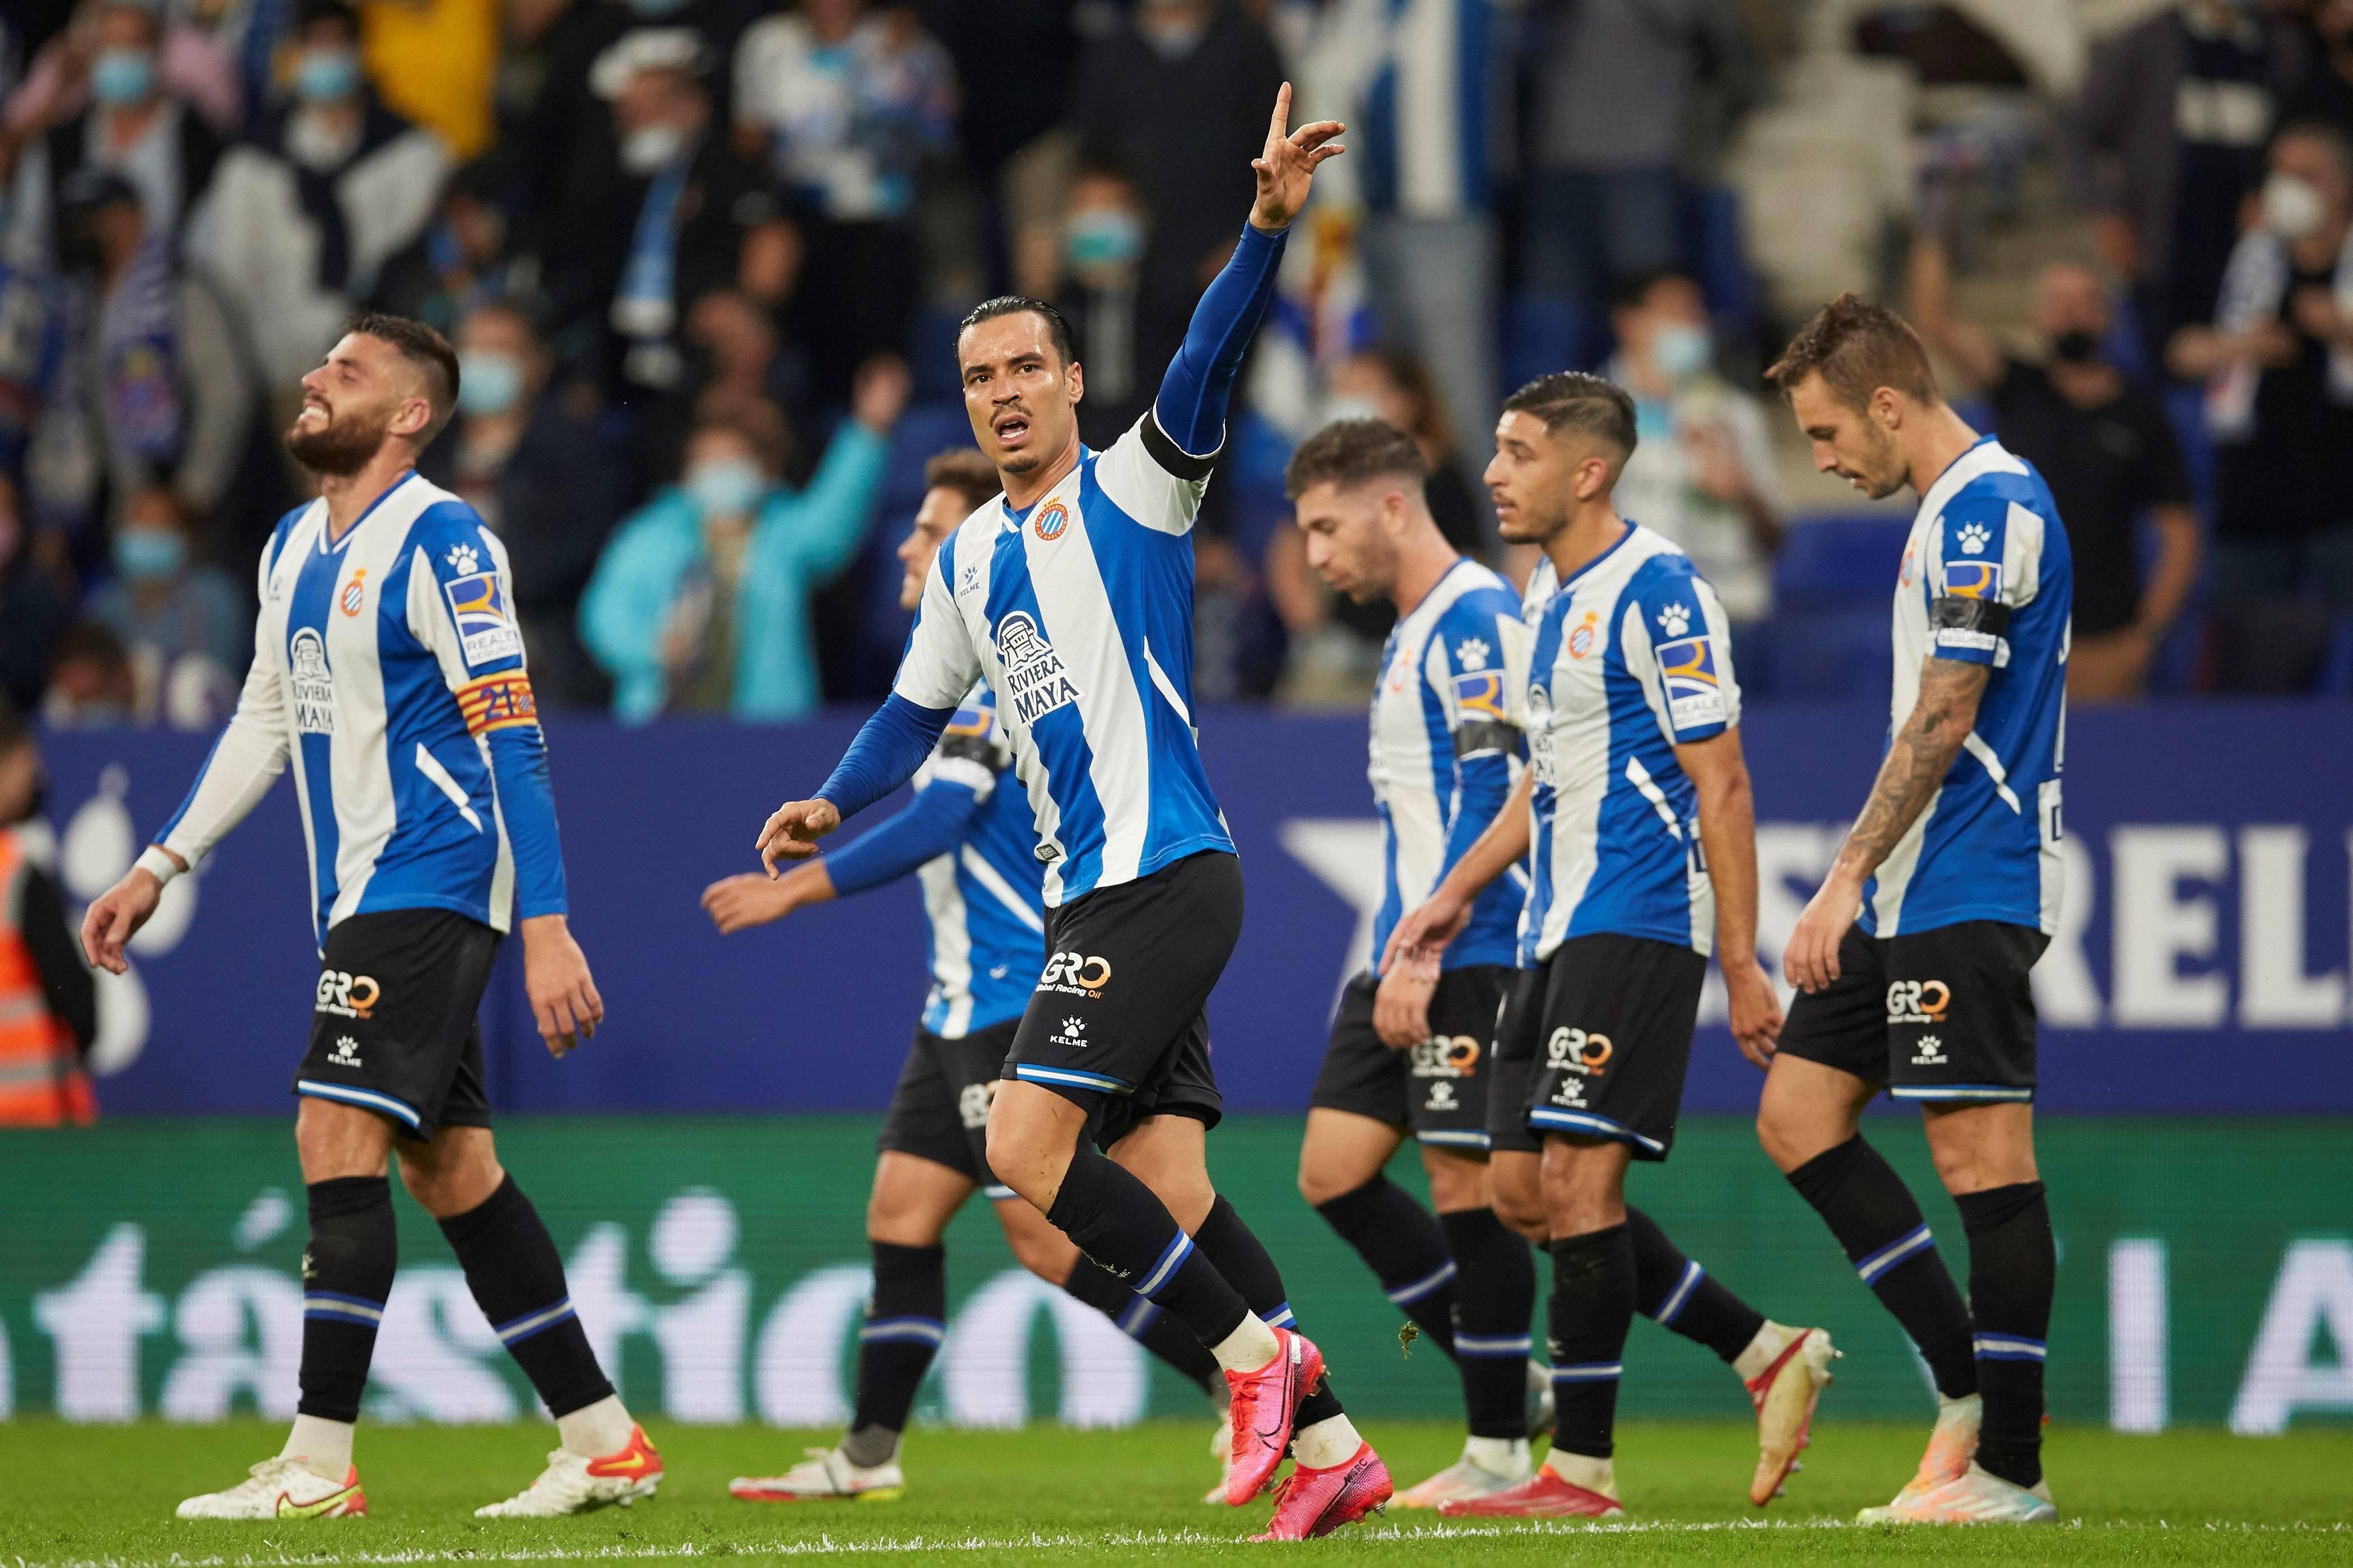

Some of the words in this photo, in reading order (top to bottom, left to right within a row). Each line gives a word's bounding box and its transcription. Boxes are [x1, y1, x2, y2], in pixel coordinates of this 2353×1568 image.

[960, 582, 980, 598] KELME
[1007, 654, 1065, 696] RIVIERA
[294, 704, 335, 732] MAYA
[480, 682, 514, 722] 21
[1013, 676, 1080, 724] MAYA
[317, 969, 381, 1009] GRO
[1041, 952, 1111, 989] GRO
[1055, 984, 1087, 997] Racing
[1088, 989, 1102, 999] Oil
[1886, 980, 1951, 1016] GRO
[1050, 1035, 1088, 1048] KELME
[1548, 1026, 1613, 1067] GRO
